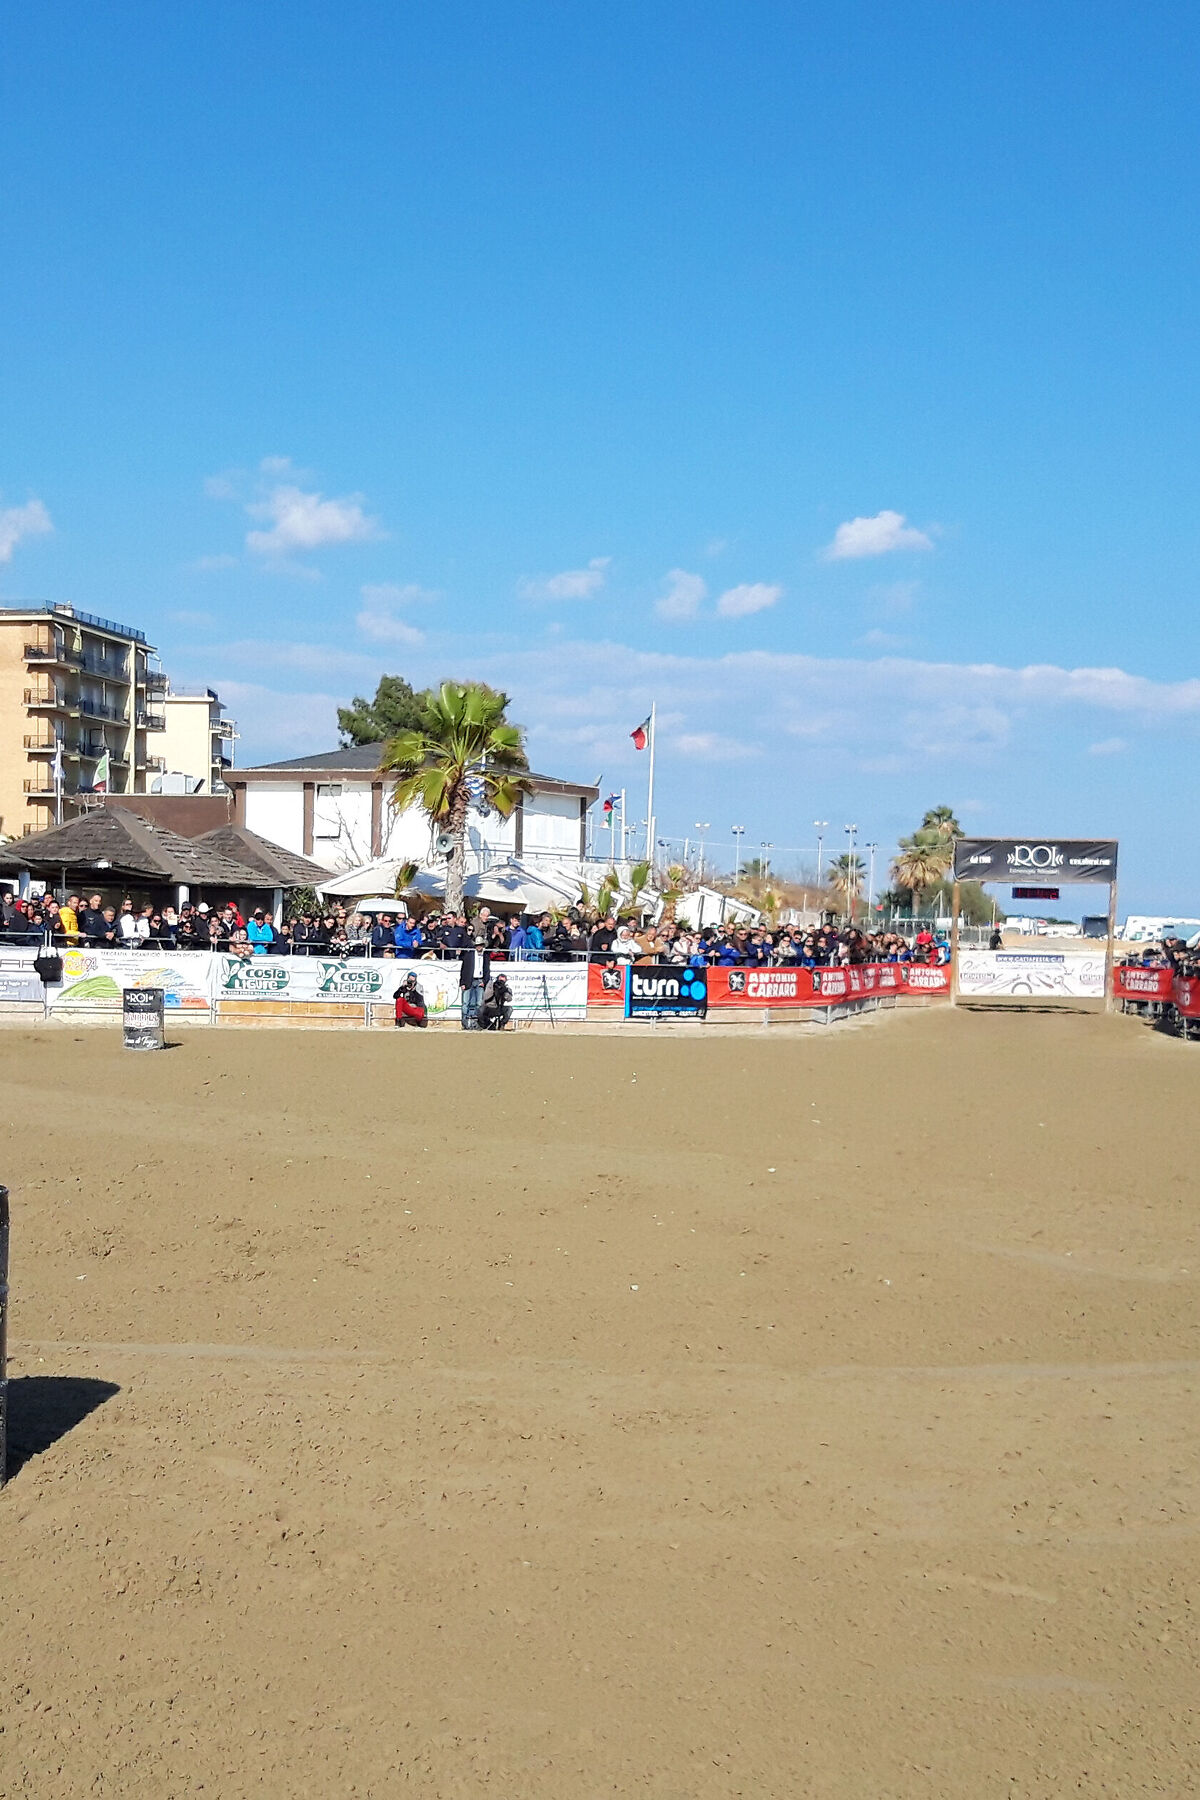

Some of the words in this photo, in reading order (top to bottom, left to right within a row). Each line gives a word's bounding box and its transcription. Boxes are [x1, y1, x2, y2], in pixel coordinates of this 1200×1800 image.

[1014, 846, 1057, 867] ROI
[749, 972, 797, 982] ANTONIO
[632, 973, 680, 996] turn
[747, 983, 797, 997] CARRARO
[130, 993, 148, 1003] ROI
